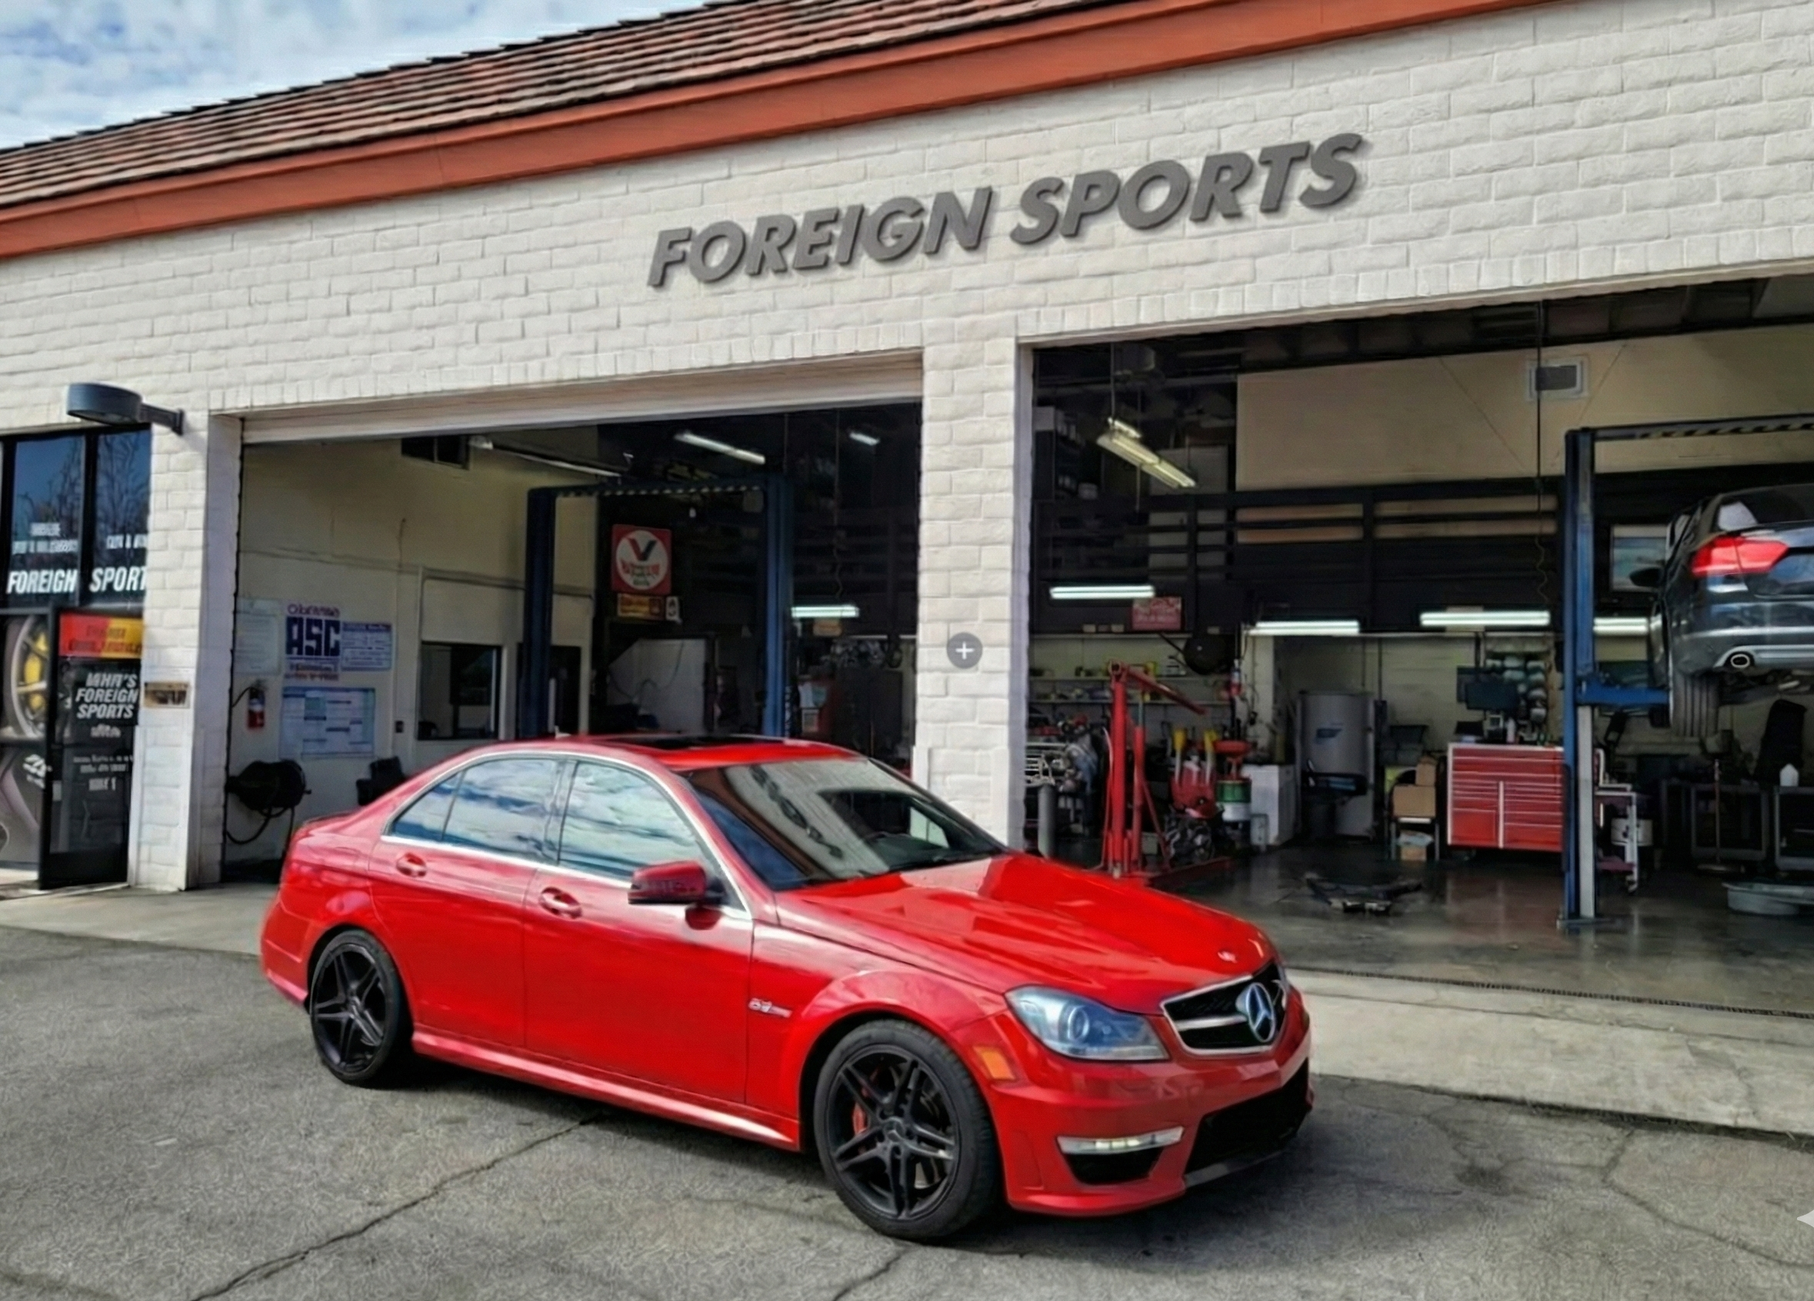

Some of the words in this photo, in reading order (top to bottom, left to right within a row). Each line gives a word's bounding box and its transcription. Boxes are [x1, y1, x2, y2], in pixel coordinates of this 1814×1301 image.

[648, 186, 993, 287] FOREIGN
[1009, 133, 1363, 245] SPORTS
[6, 569, 78, 594] FOREIGN
[75, 687, 139, 703] FOREIGN
[76, 703, 135, 719] SPORTS
